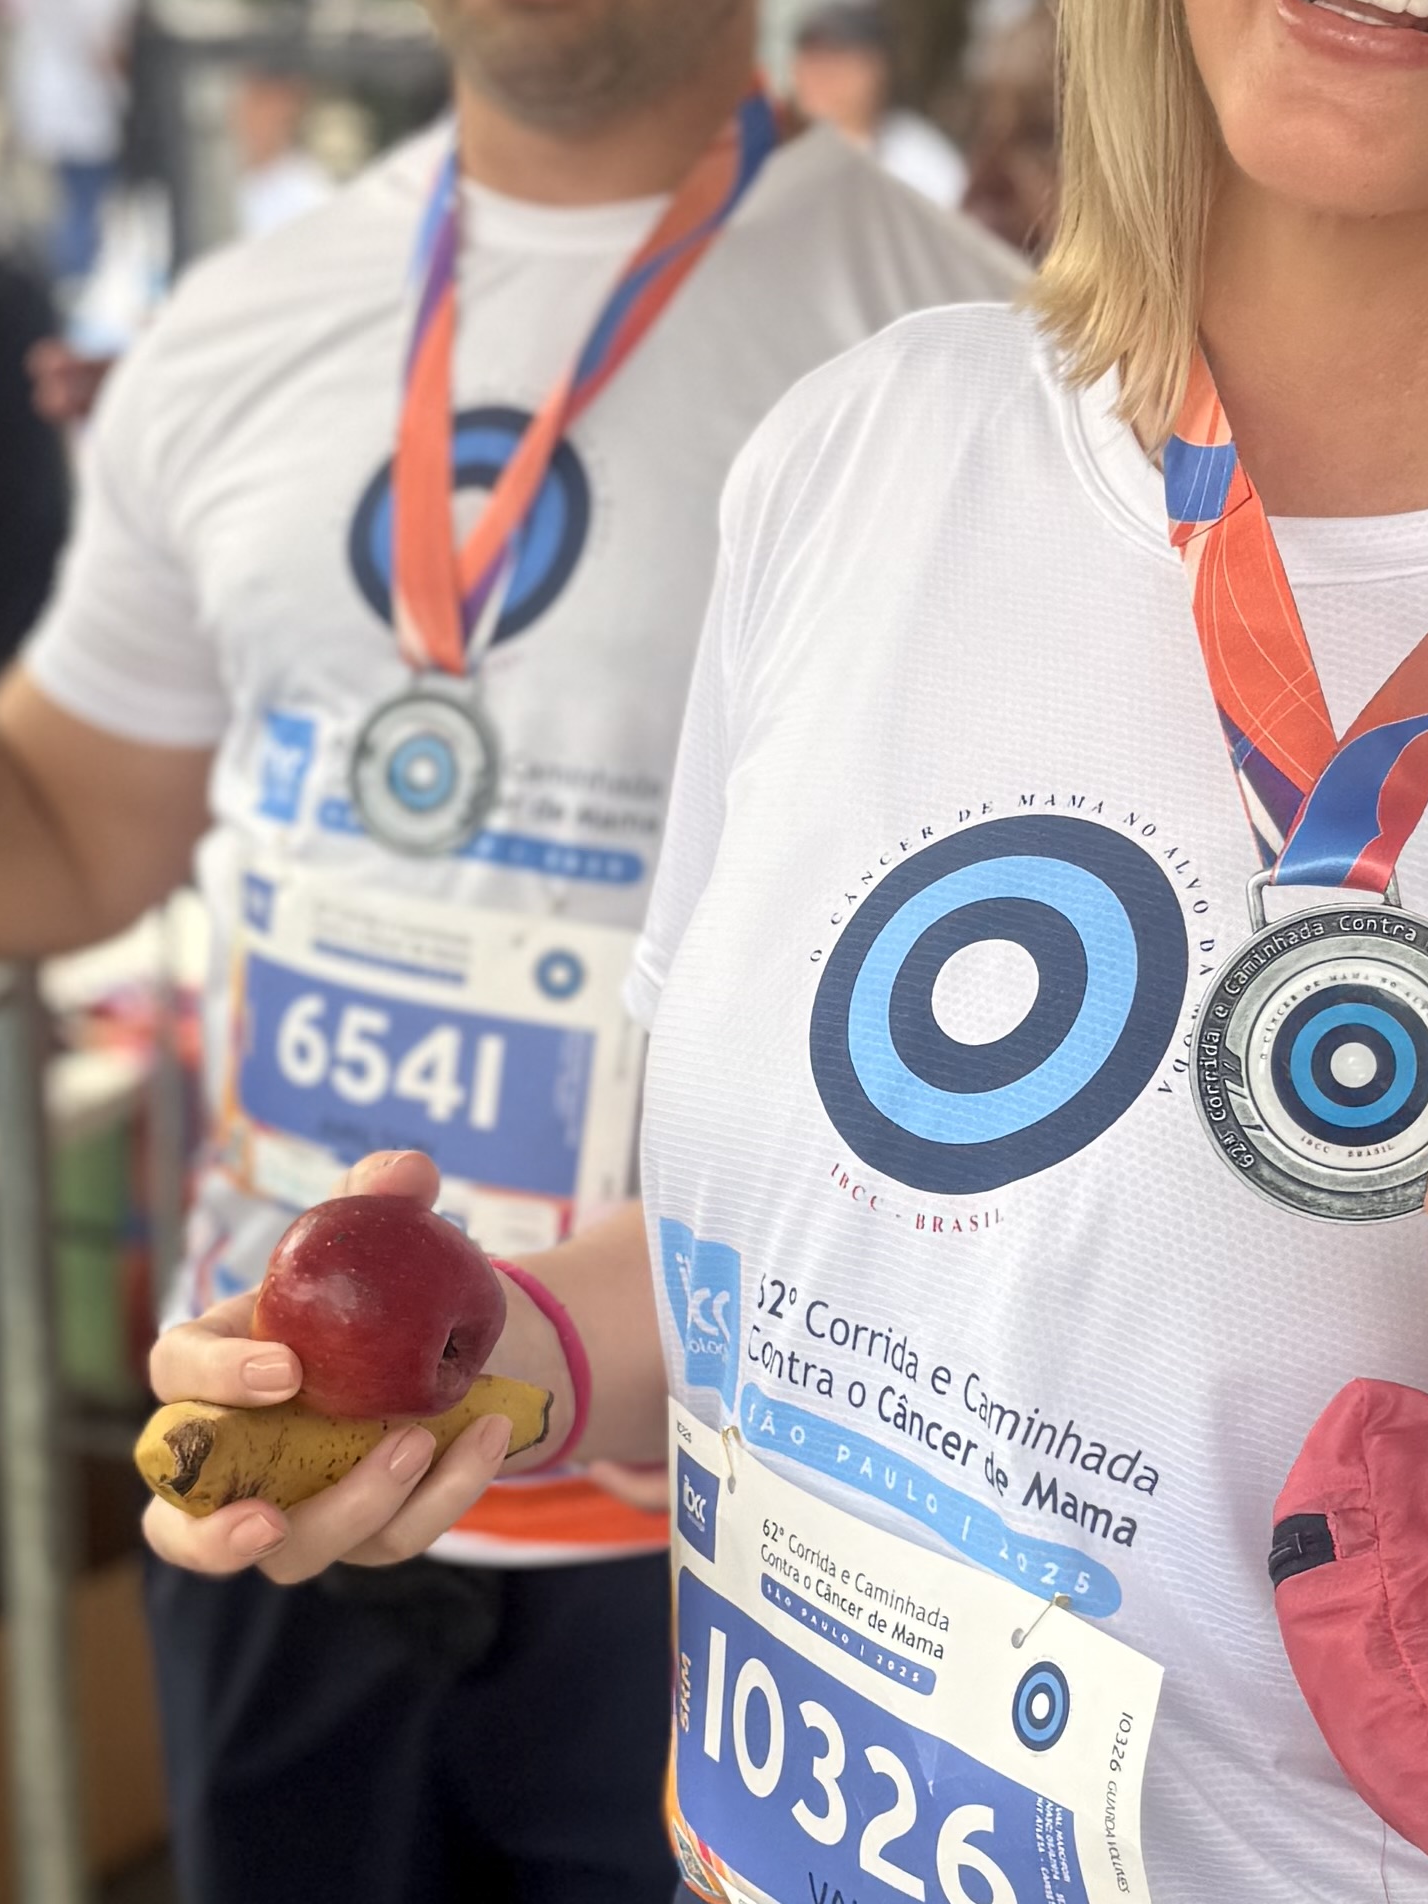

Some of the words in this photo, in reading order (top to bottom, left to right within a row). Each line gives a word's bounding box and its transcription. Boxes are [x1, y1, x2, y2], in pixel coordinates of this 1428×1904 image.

[958, 801, 995, 823] DE
[1019, 793, 1105, 815] MAMA
[1124, 811, 1157, 838] NO
[1163, 845, 1210, 915] ALVO
[1224, 921, 1325, 996] Caminhada
[1339, 915, 1417, 943] Contra
[278, 992, 506, 1131] 6541
[915, 1209, 1005, 1234] BRASIL
[747, 1324, 834, 1399] Contra
[847, 1380, 866, 1409] o
[877, 1385, 978, 1467] Câncer
[984, 1451, 1009, 1497] de
[1022, 1471, 1138, 1548] Mama
[805, 1300, 919, 1383] Corrida
[930, 1365, 952, 1396] e
[963, 1372, 1160, 1497] Caminhada
[747, 1403, 806, 1446] SÃO
[835, 1444, 938, 1514] PAULO
[998, 1538, 1090, 1595] 2025
[760, 1544, 800, 1584] Contra
[803, 1575, 812, 1590] o
[815, 1579, 864, 1621] Câncer
[868, 1610, 887, 1633] de
[891, 1621, 945, 1660] Mama
[788, 1534, 836, 1578] Corrida
[840, 1568, 851, 1584] e
[855, 1573, 950, 1633] Caminhada
[801, 1607, 849, 1644] PAULO
[1109, 1711, 1134, 1772] 10326
